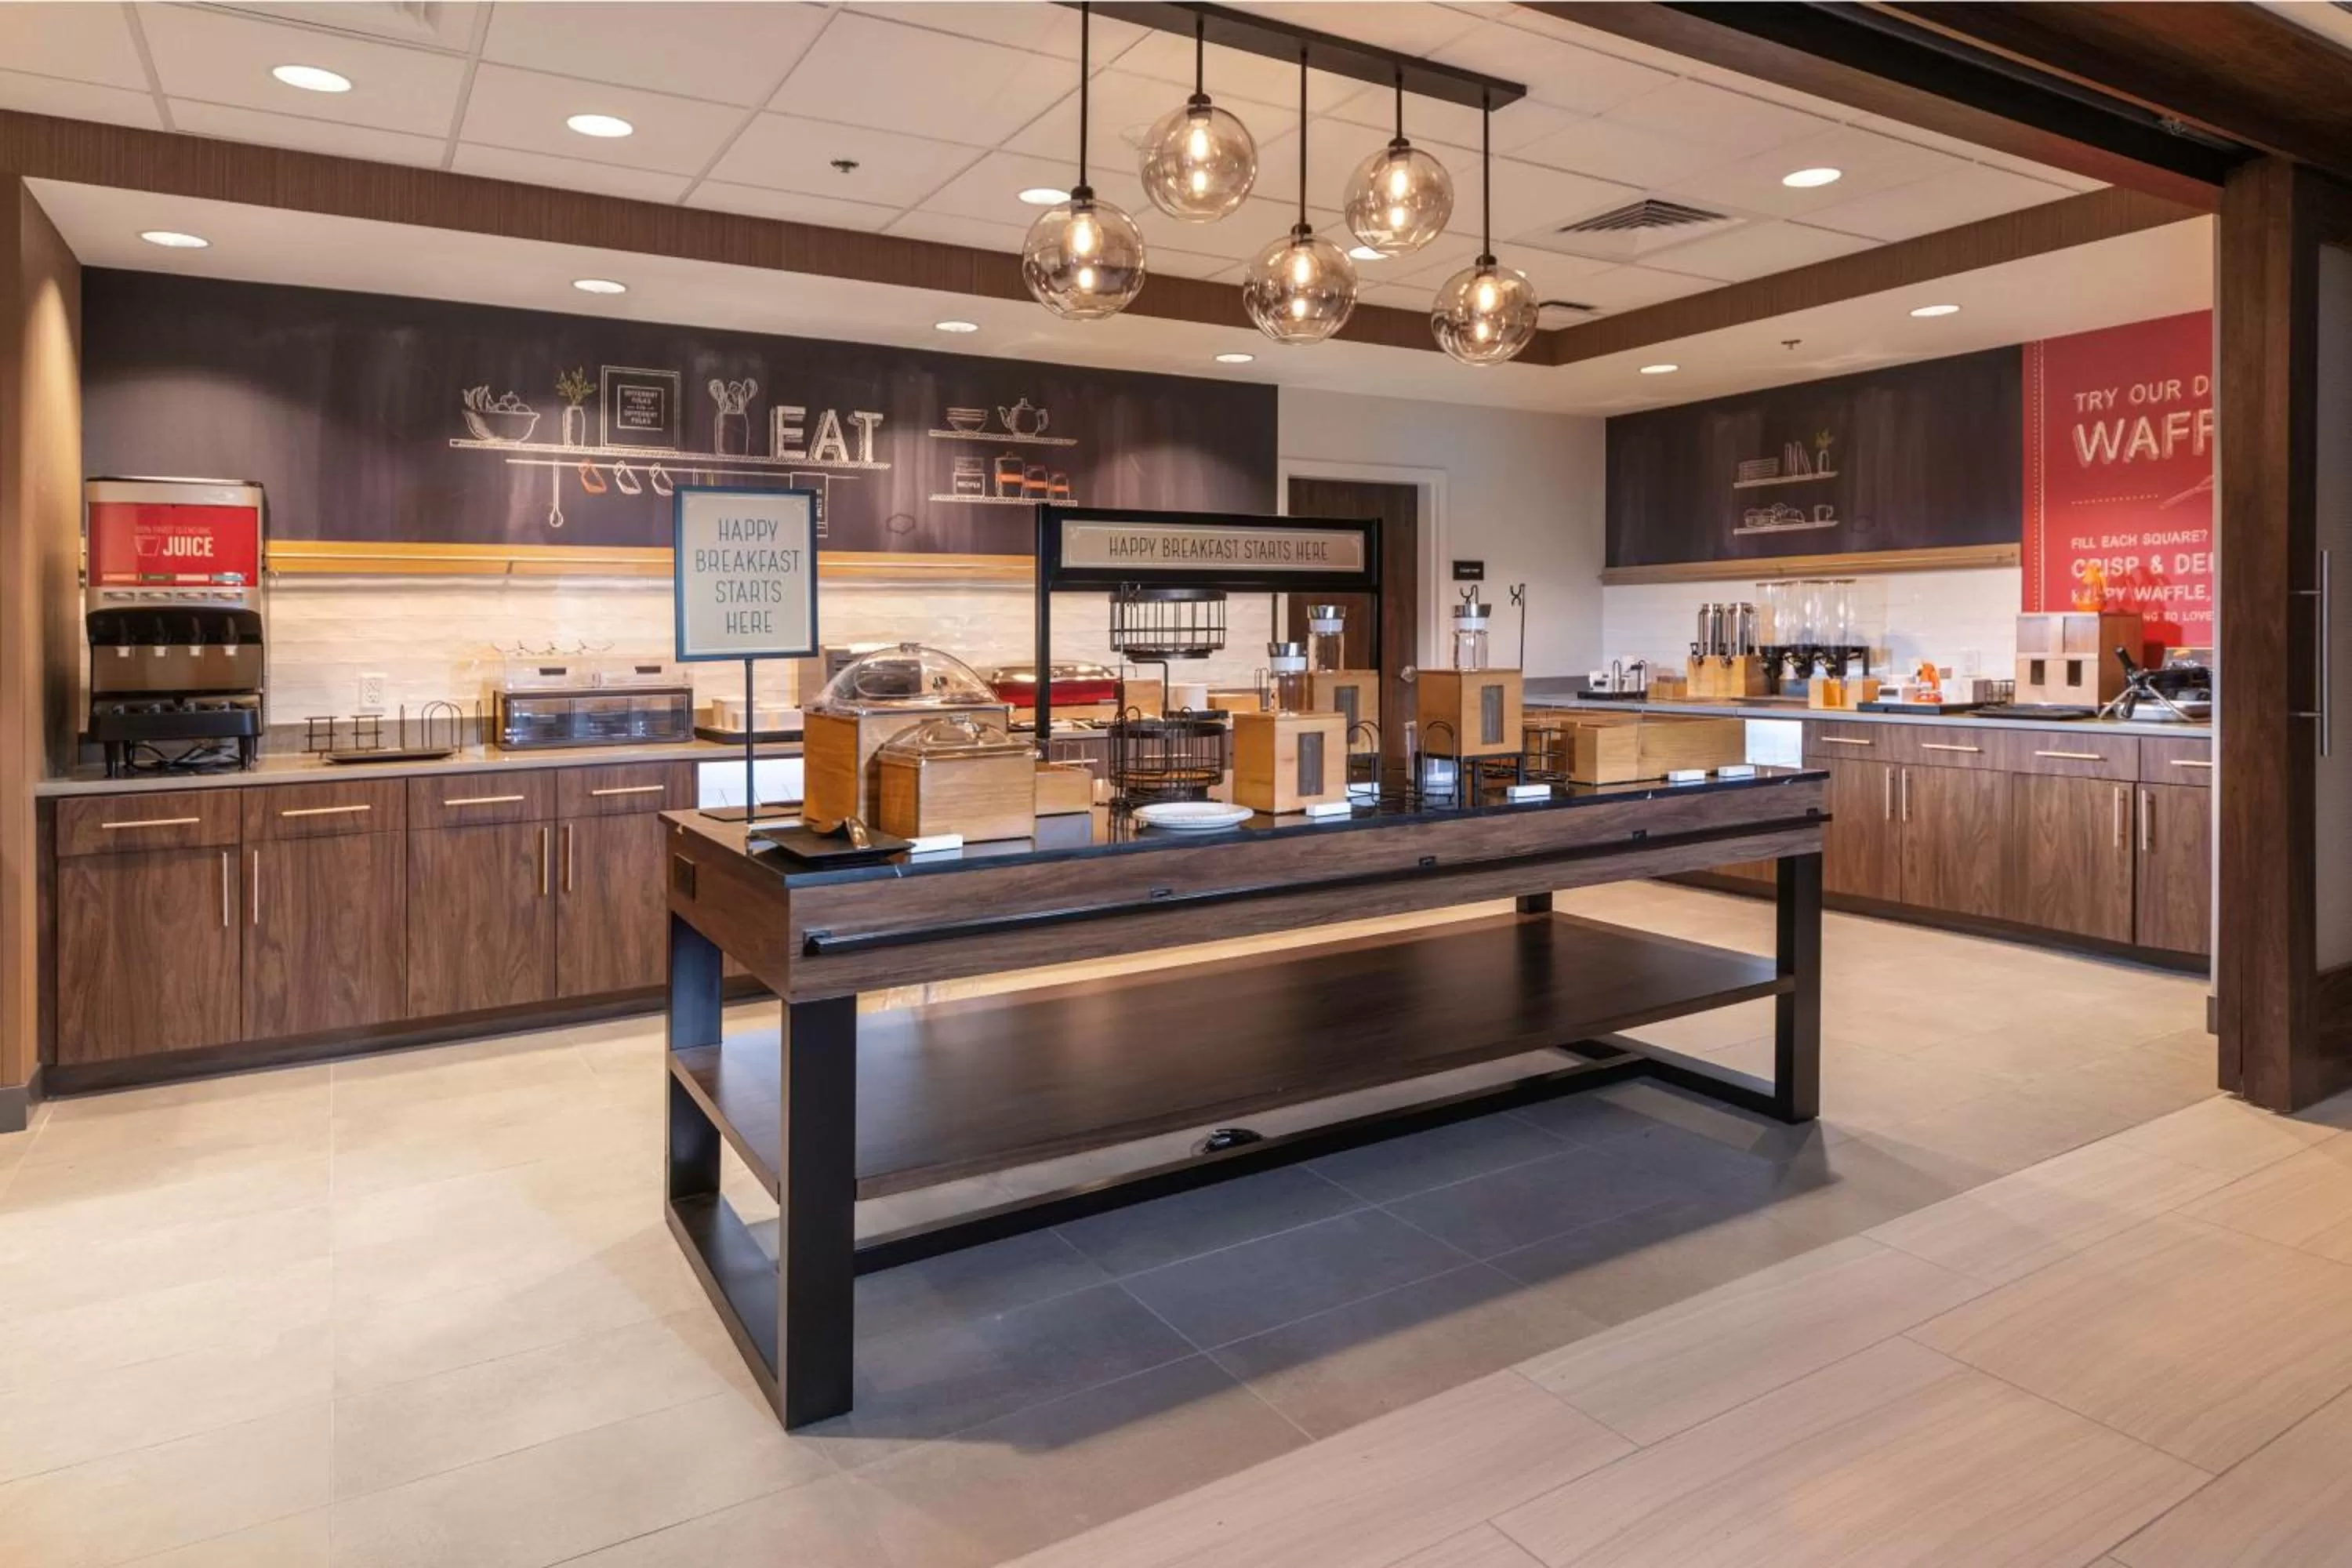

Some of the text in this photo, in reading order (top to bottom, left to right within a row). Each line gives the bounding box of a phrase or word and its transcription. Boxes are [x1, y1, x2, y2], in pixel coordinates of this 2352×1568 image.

[2074, 375, 2213, 413] TRY OUR D
[770, 405, 884, 463] EAT
[718, 518, 779, 542] HAPPY
[2071, 528, 2209, 550] FILL EACH SQUARE?
[163, 535, 213, 557] JUICE
[1109, 535, 1330, 561] HAPPY BREAKFAST STARTS HERE
[695, 549, 800, 573] BREAKFAST
[2151, 554, 2165, 575] &
[716, 579, 782, 603] STARTS
[2133, 584, 2212, 604] WAFFLE,
[727, 611, 773, 634] HERE
